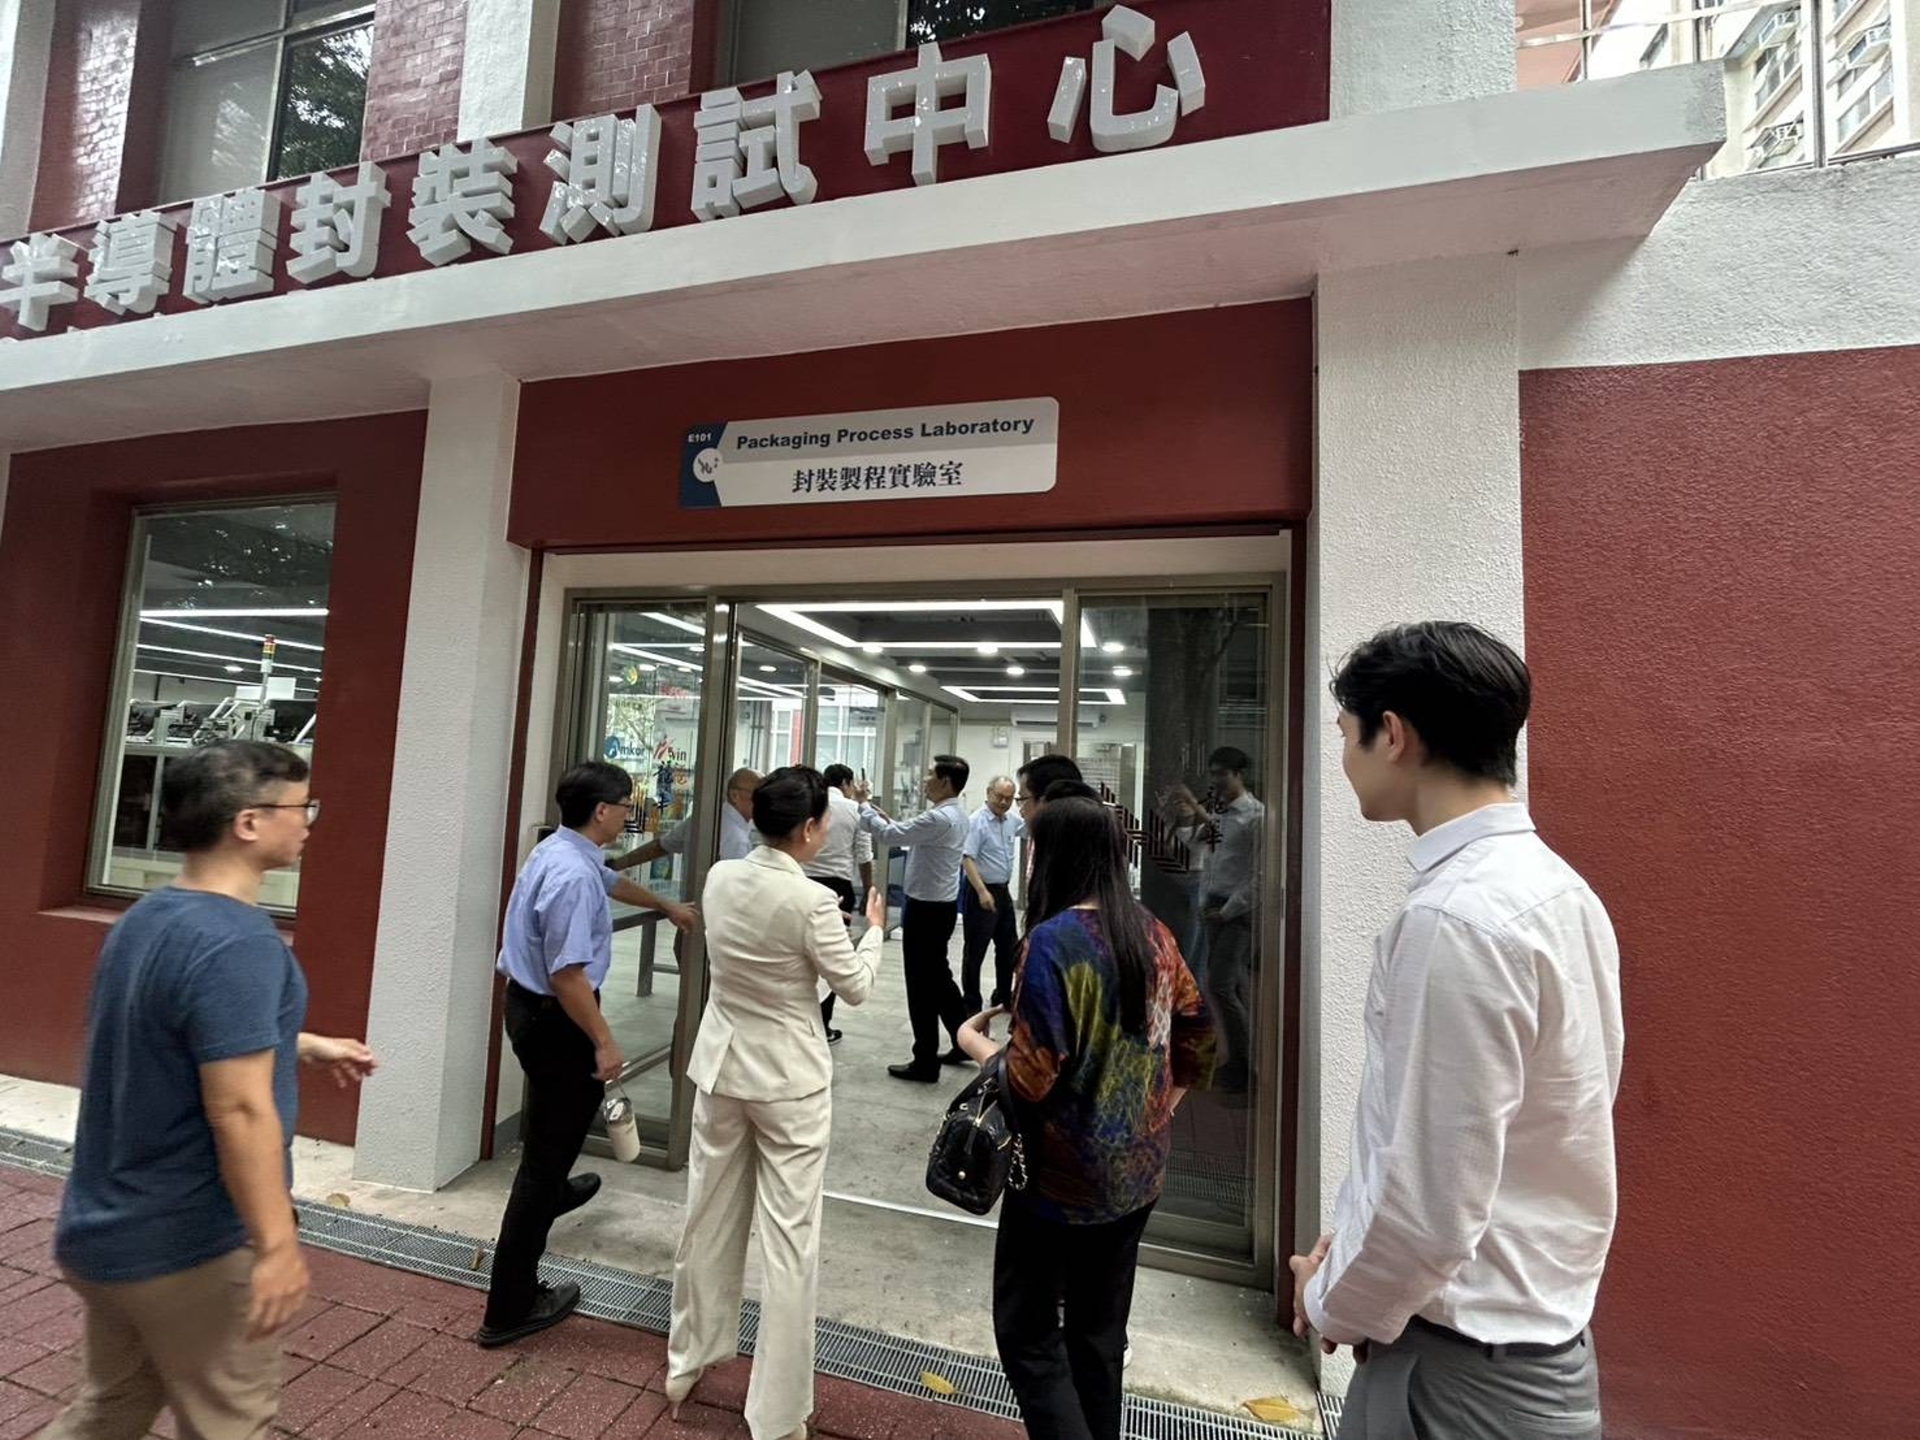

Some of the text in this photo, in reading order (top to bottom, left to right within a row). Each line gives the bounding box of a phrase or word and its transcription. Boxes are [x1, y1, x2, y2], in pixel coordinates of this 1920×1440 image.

[0, 4, 1206, 333] 半導體封裝測試中心
[688, 433, 712, 443] E101
[736, 418, 1034, 450] Packaging Process Laboratory
[792, 460, 963, 493] 封裝製程實驗室
